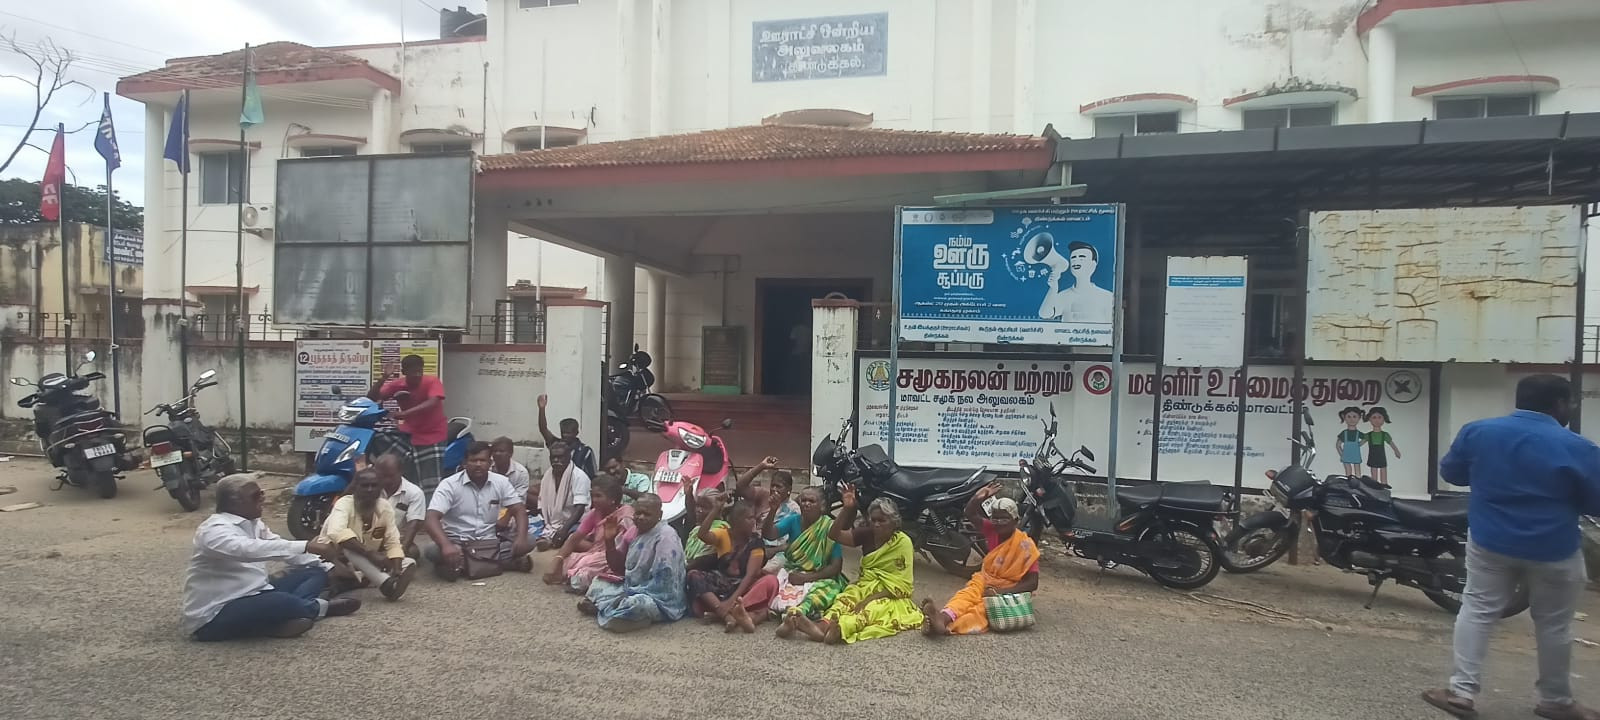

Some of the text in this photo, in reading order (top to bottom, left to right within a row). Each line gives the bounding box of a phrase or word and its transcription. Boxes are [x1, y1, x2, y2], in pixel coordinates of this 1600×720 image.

[760, 21, 875, 44] ஊராட்சி ஒன்றிய
[777, 38, 864, 58] அலுவலகம்
[948, 234, 973, 247] நம்ம
[933, 243, 989, 270] ஊரு
[937, 269, 984, 289] சூப்பரு
[299, 353, 309, 363] 12
[896, 363, 1074, 397] சமூகநலன் மற்றும்
[1128, 367, 1203, 396] மகளிர்
[900, 393, 1035, 407] மாவட்ட சமூக நல அலுவலகம்
[1162, 399, 1239, 413] திண்டுக்கல்
